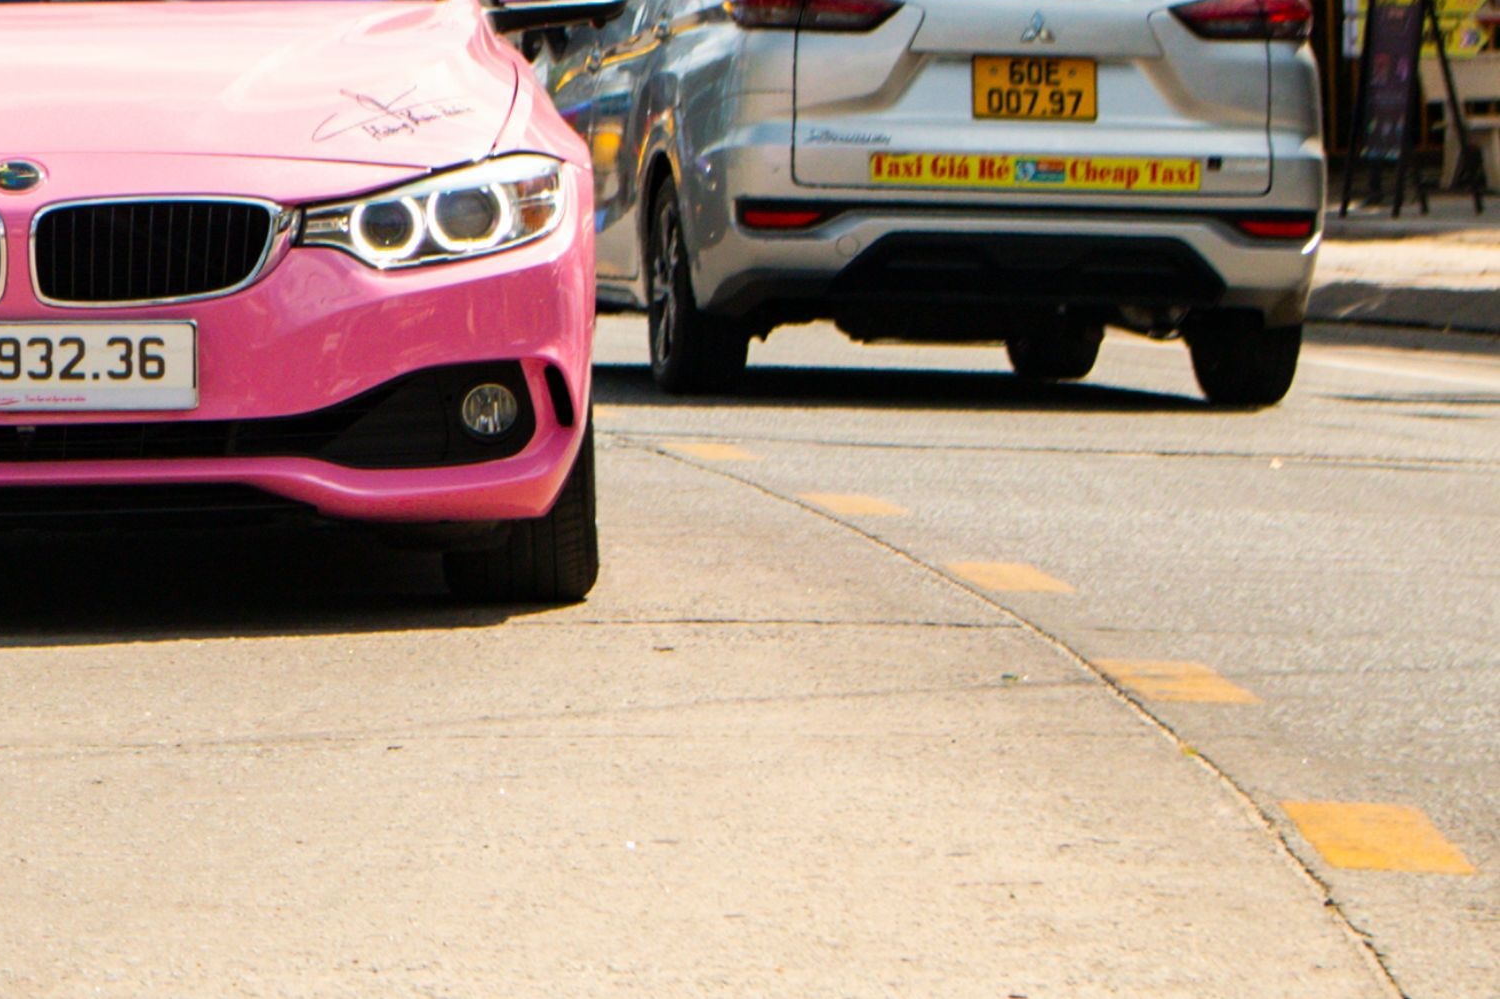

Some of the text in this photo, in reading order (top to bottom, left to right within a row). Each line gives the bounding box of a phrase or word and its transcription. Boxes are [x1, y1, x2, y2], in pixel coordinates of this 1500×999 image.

[1008, 58, 1061, 86] 60E
[987, 87, 1083, 116] 007.97
[872, 153, 923, 177] Taxi
[1069, 158, 1139, 189] Cheap
[1146, 160, 1197, 185] Taxi
